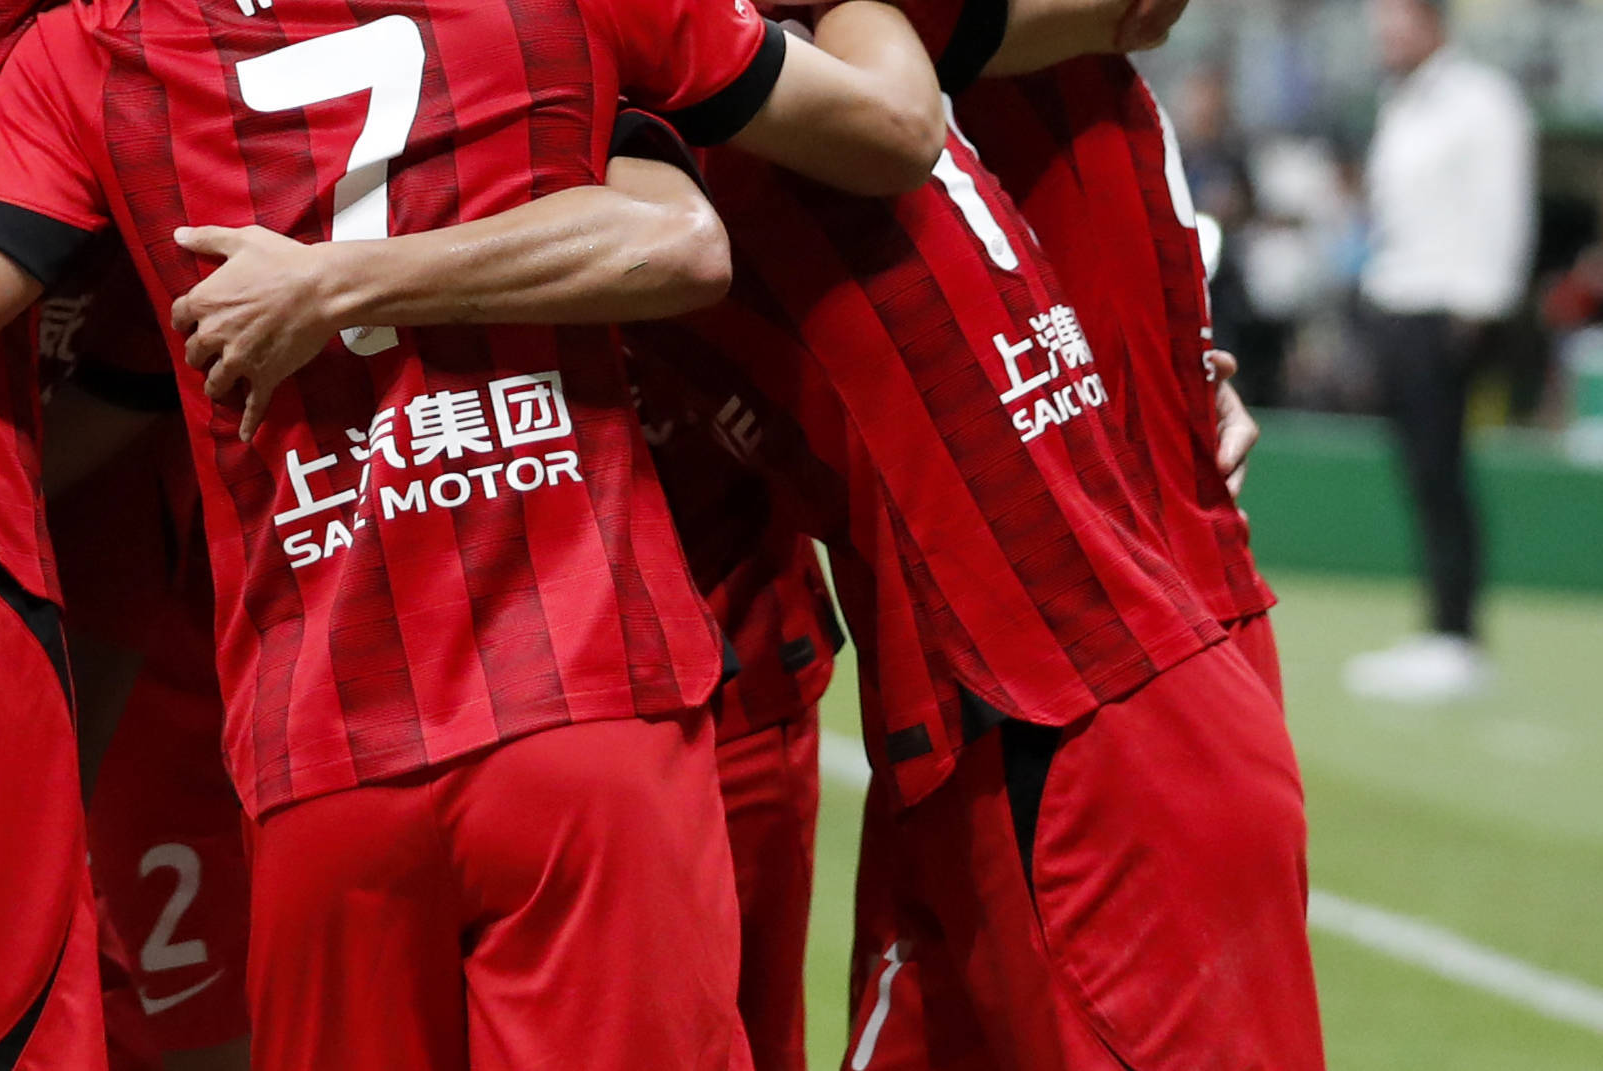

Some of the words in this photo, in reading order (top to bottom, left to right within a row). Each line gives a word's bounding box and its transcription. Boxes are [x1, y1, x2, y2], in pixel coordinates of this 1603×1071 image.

[235, 14, 426, 356] 7
[273, 370, 574, 527] 上汽集团
[1012, 385, 1082, 443] SAIC
[282, 495, 368, 569] SA
[379, 450, 584, 521] MOTOR
[140, 842, 208, 972] 2
